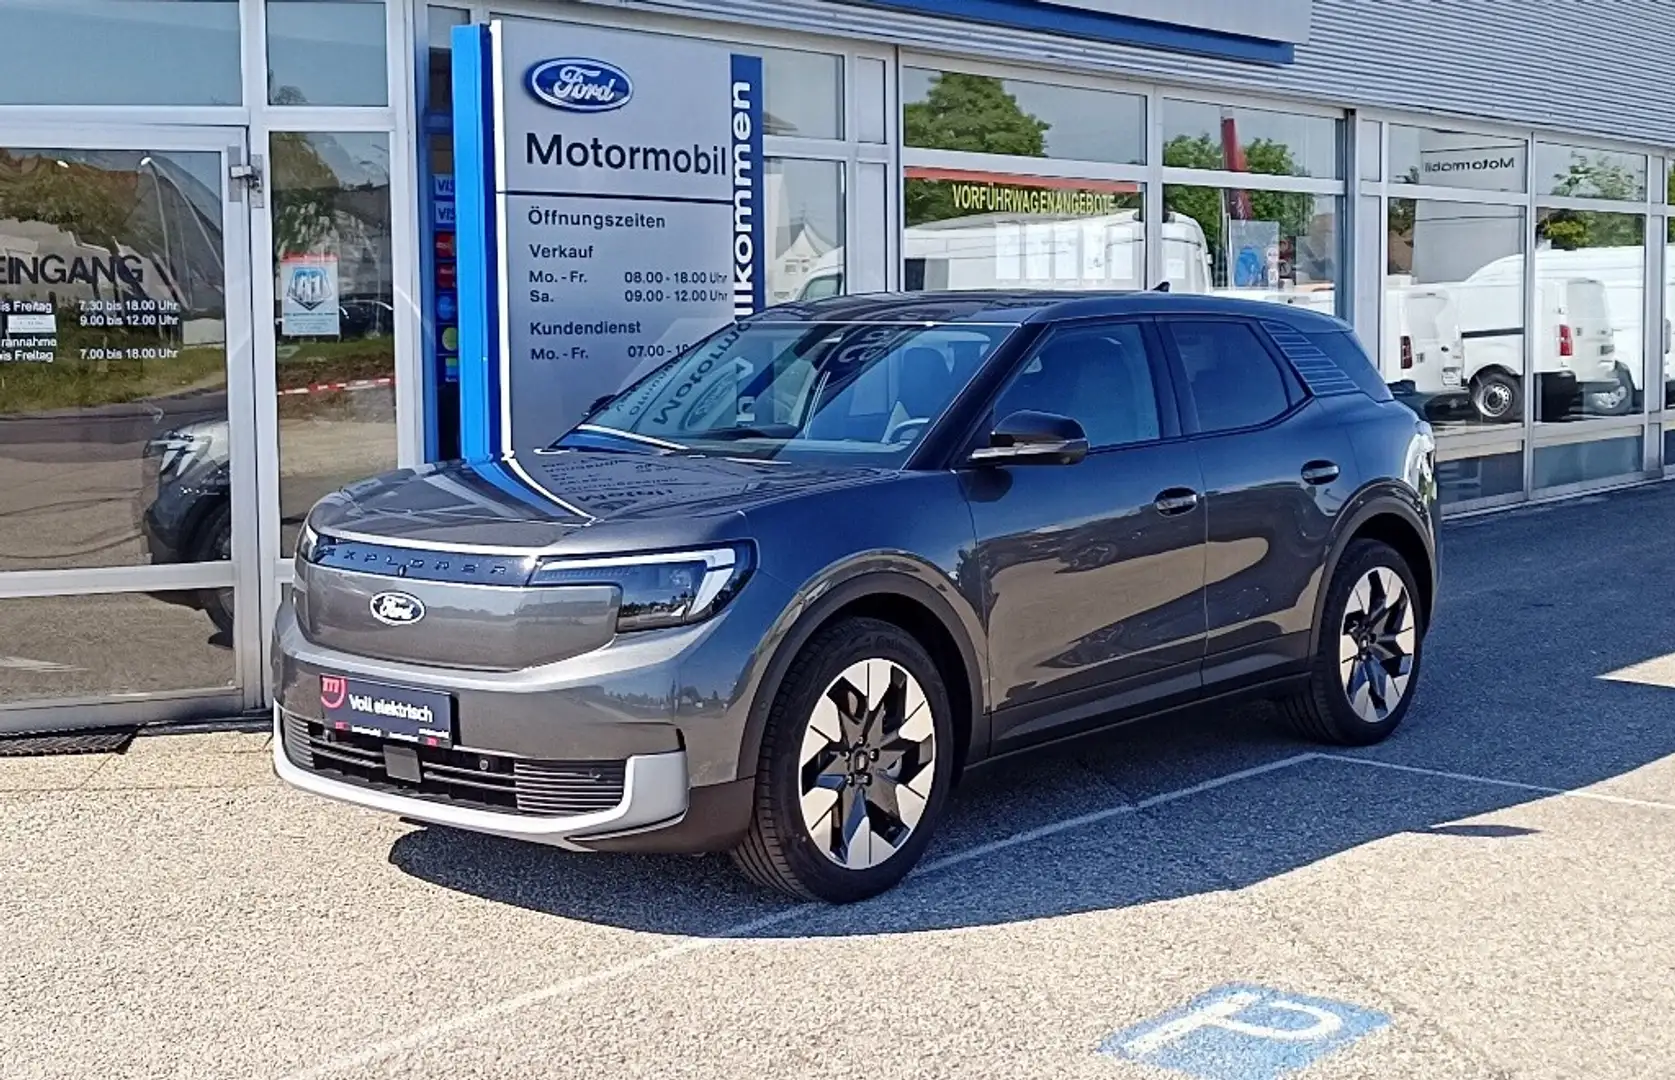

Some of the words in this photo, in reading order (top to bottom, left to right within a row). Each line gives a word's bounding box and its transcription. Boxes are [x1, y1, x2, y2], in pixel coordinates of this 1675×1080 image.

[553, 65, 619, 101] Ford
[526, 132, 727, 175] Motormobil
[733, 81, 754, 316] llkommen
[952, 182, 1116, 215] VORFÜHRWAGENANGEBOTE
[528, 205, 666, 230] Öffnungszeiten
[529, 244, 593, 259] Verkauf
[529, 270, 558, 283] Mo.
[570, 270, 587, 283] Fr.
[624, 271, 663, 284] 08.00
[674, 271, 707, 284] 18.00
[709, 271, 728, 284] Uhr
[530, 290, 554, 303] Sa.
[624, 290, 664, 303] 09.00
[675, 290, 707, 303] 12.00
[709, 290, 728, 302] Uhr
[13, 300, 52, 313] Freitag
[80, 300, 103, 311] 7.30
[106, 300, 122, 311] bis
[126, 300, 155, 311] 18.00
[158, 300, 179, 311] Uhr
[80, 315, 105, 326] 9.00
[106, 315, 123, 325] bis
[126, 315, 156, 325] 12.00
[158, 315, 180, 325] Uhr
[529, 320, 642, 336] Kundendienst
[15, 350, 54, 362] Freitag
[80, 349, 105, 359] 7.00
[106, 349, 122, 359] bis
[126, 349, 156, 359] 18.00
[158, 349, 179, 359] Uhr
[531, 348, 559, 361] Mo.
[571, 348, 589, 360] Fr.
[627, 345, 665, 358] 07.00
[322, 546, 507, 576] EXPLORER
[379, 593, 414, 620] Ford
[348, 694, 373, 713] Voll
[373, 699, 434, 723] elektrisch
[1120, 991, 1343, 1055] P
